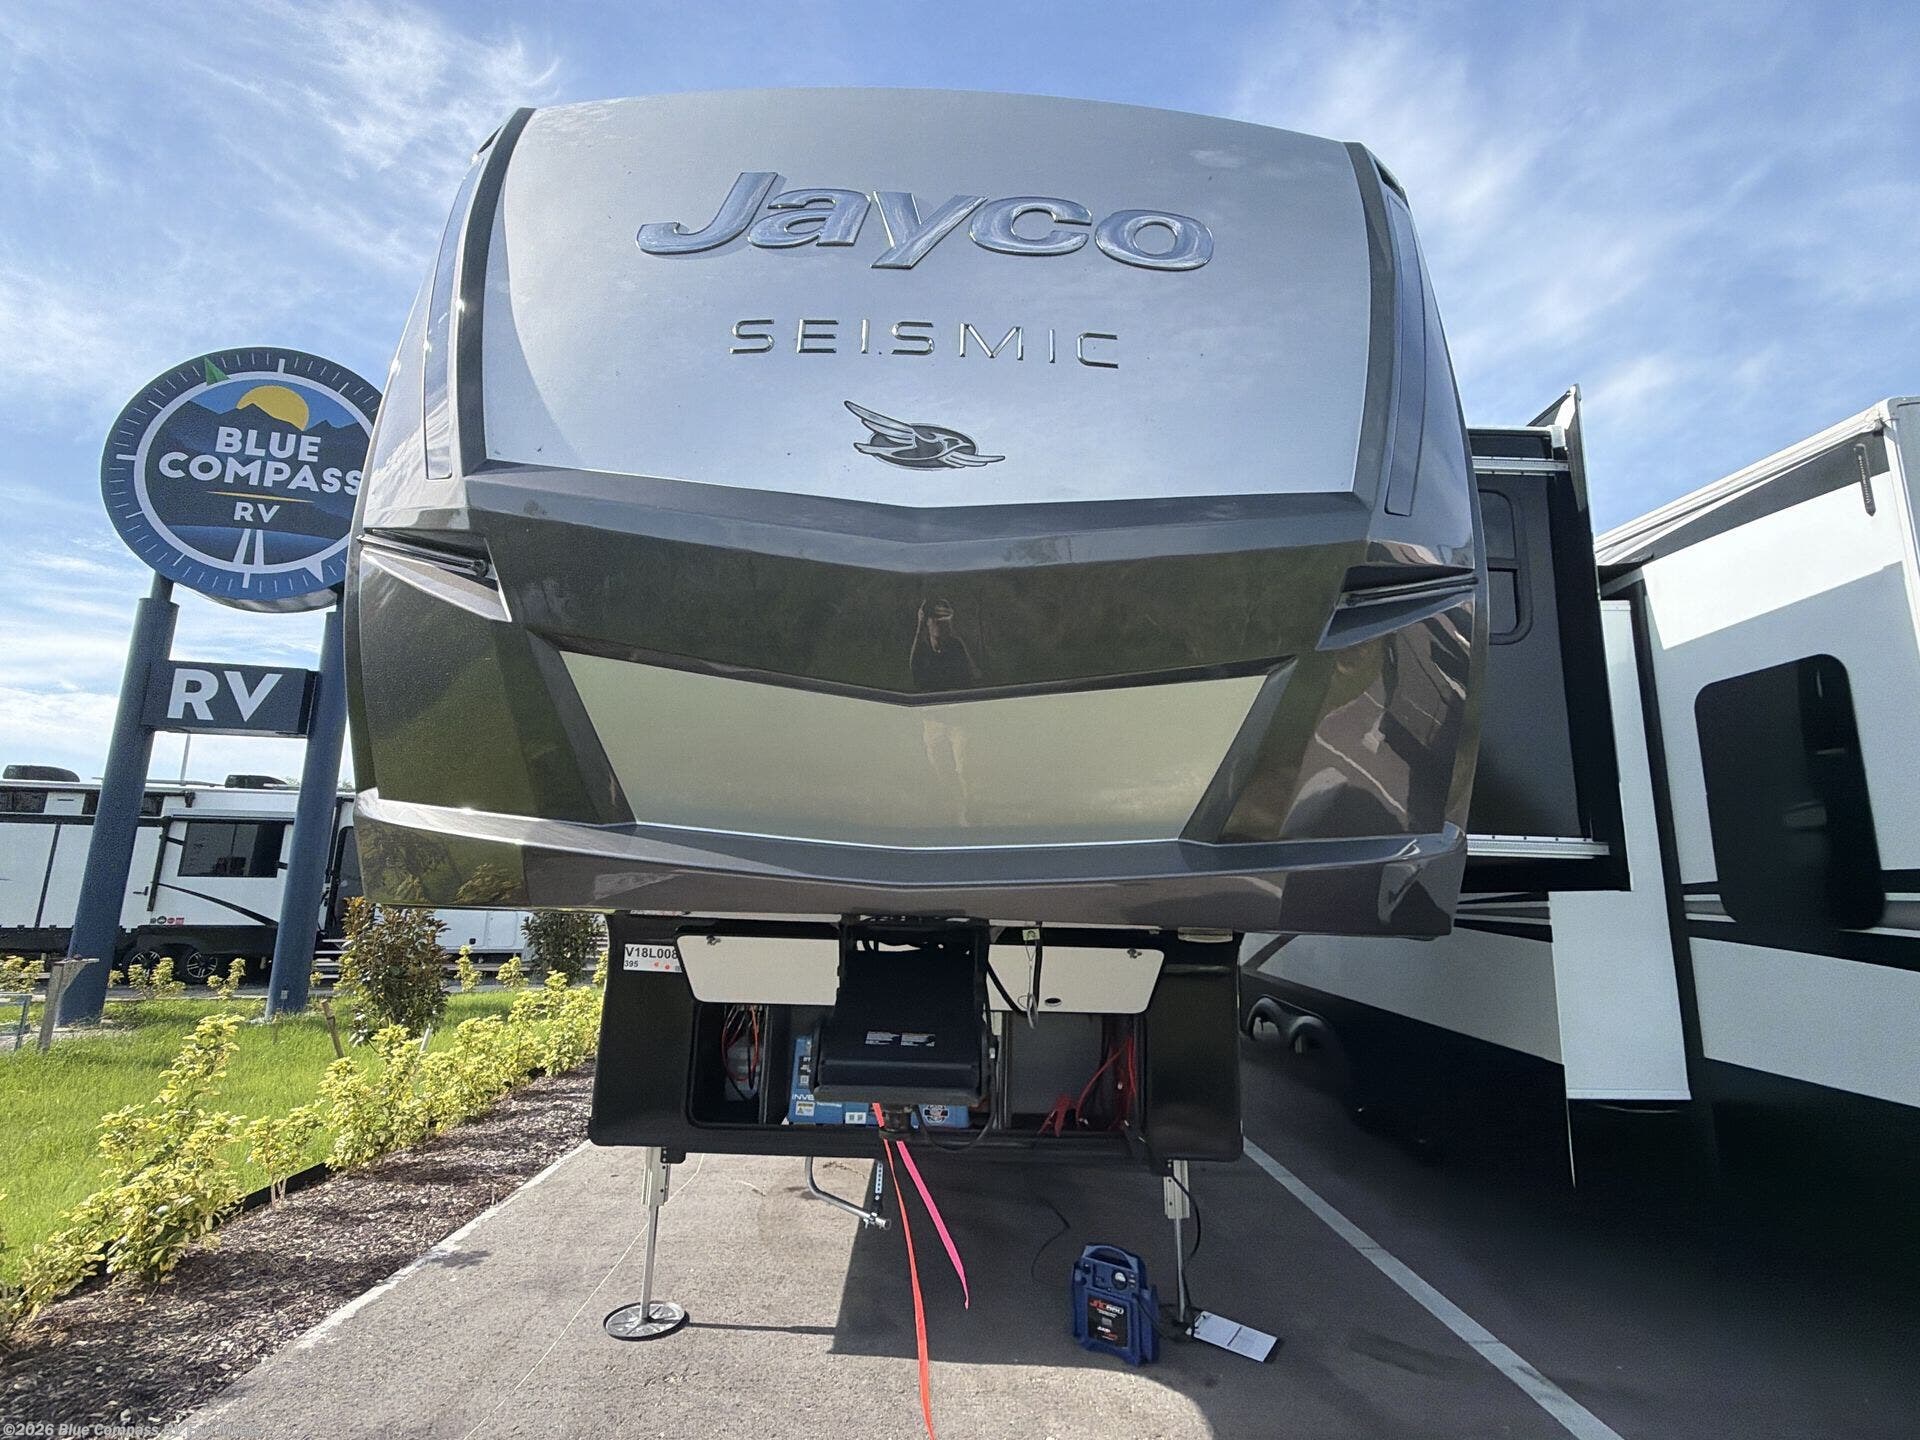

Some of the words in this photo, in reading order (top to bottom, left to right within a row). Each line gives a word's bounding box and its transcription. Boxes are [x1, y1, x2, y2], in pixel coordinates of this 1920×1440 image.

[636, 172, 1214, 272] Jayco
[729, 318, 1119, 369] SEISMIC
[214, 426, 322, 463] BLUE
[158, 451, 362, 496] COMPASS
[233, 501, 280, 524] RV
[166, 667, 282, 723] RV
